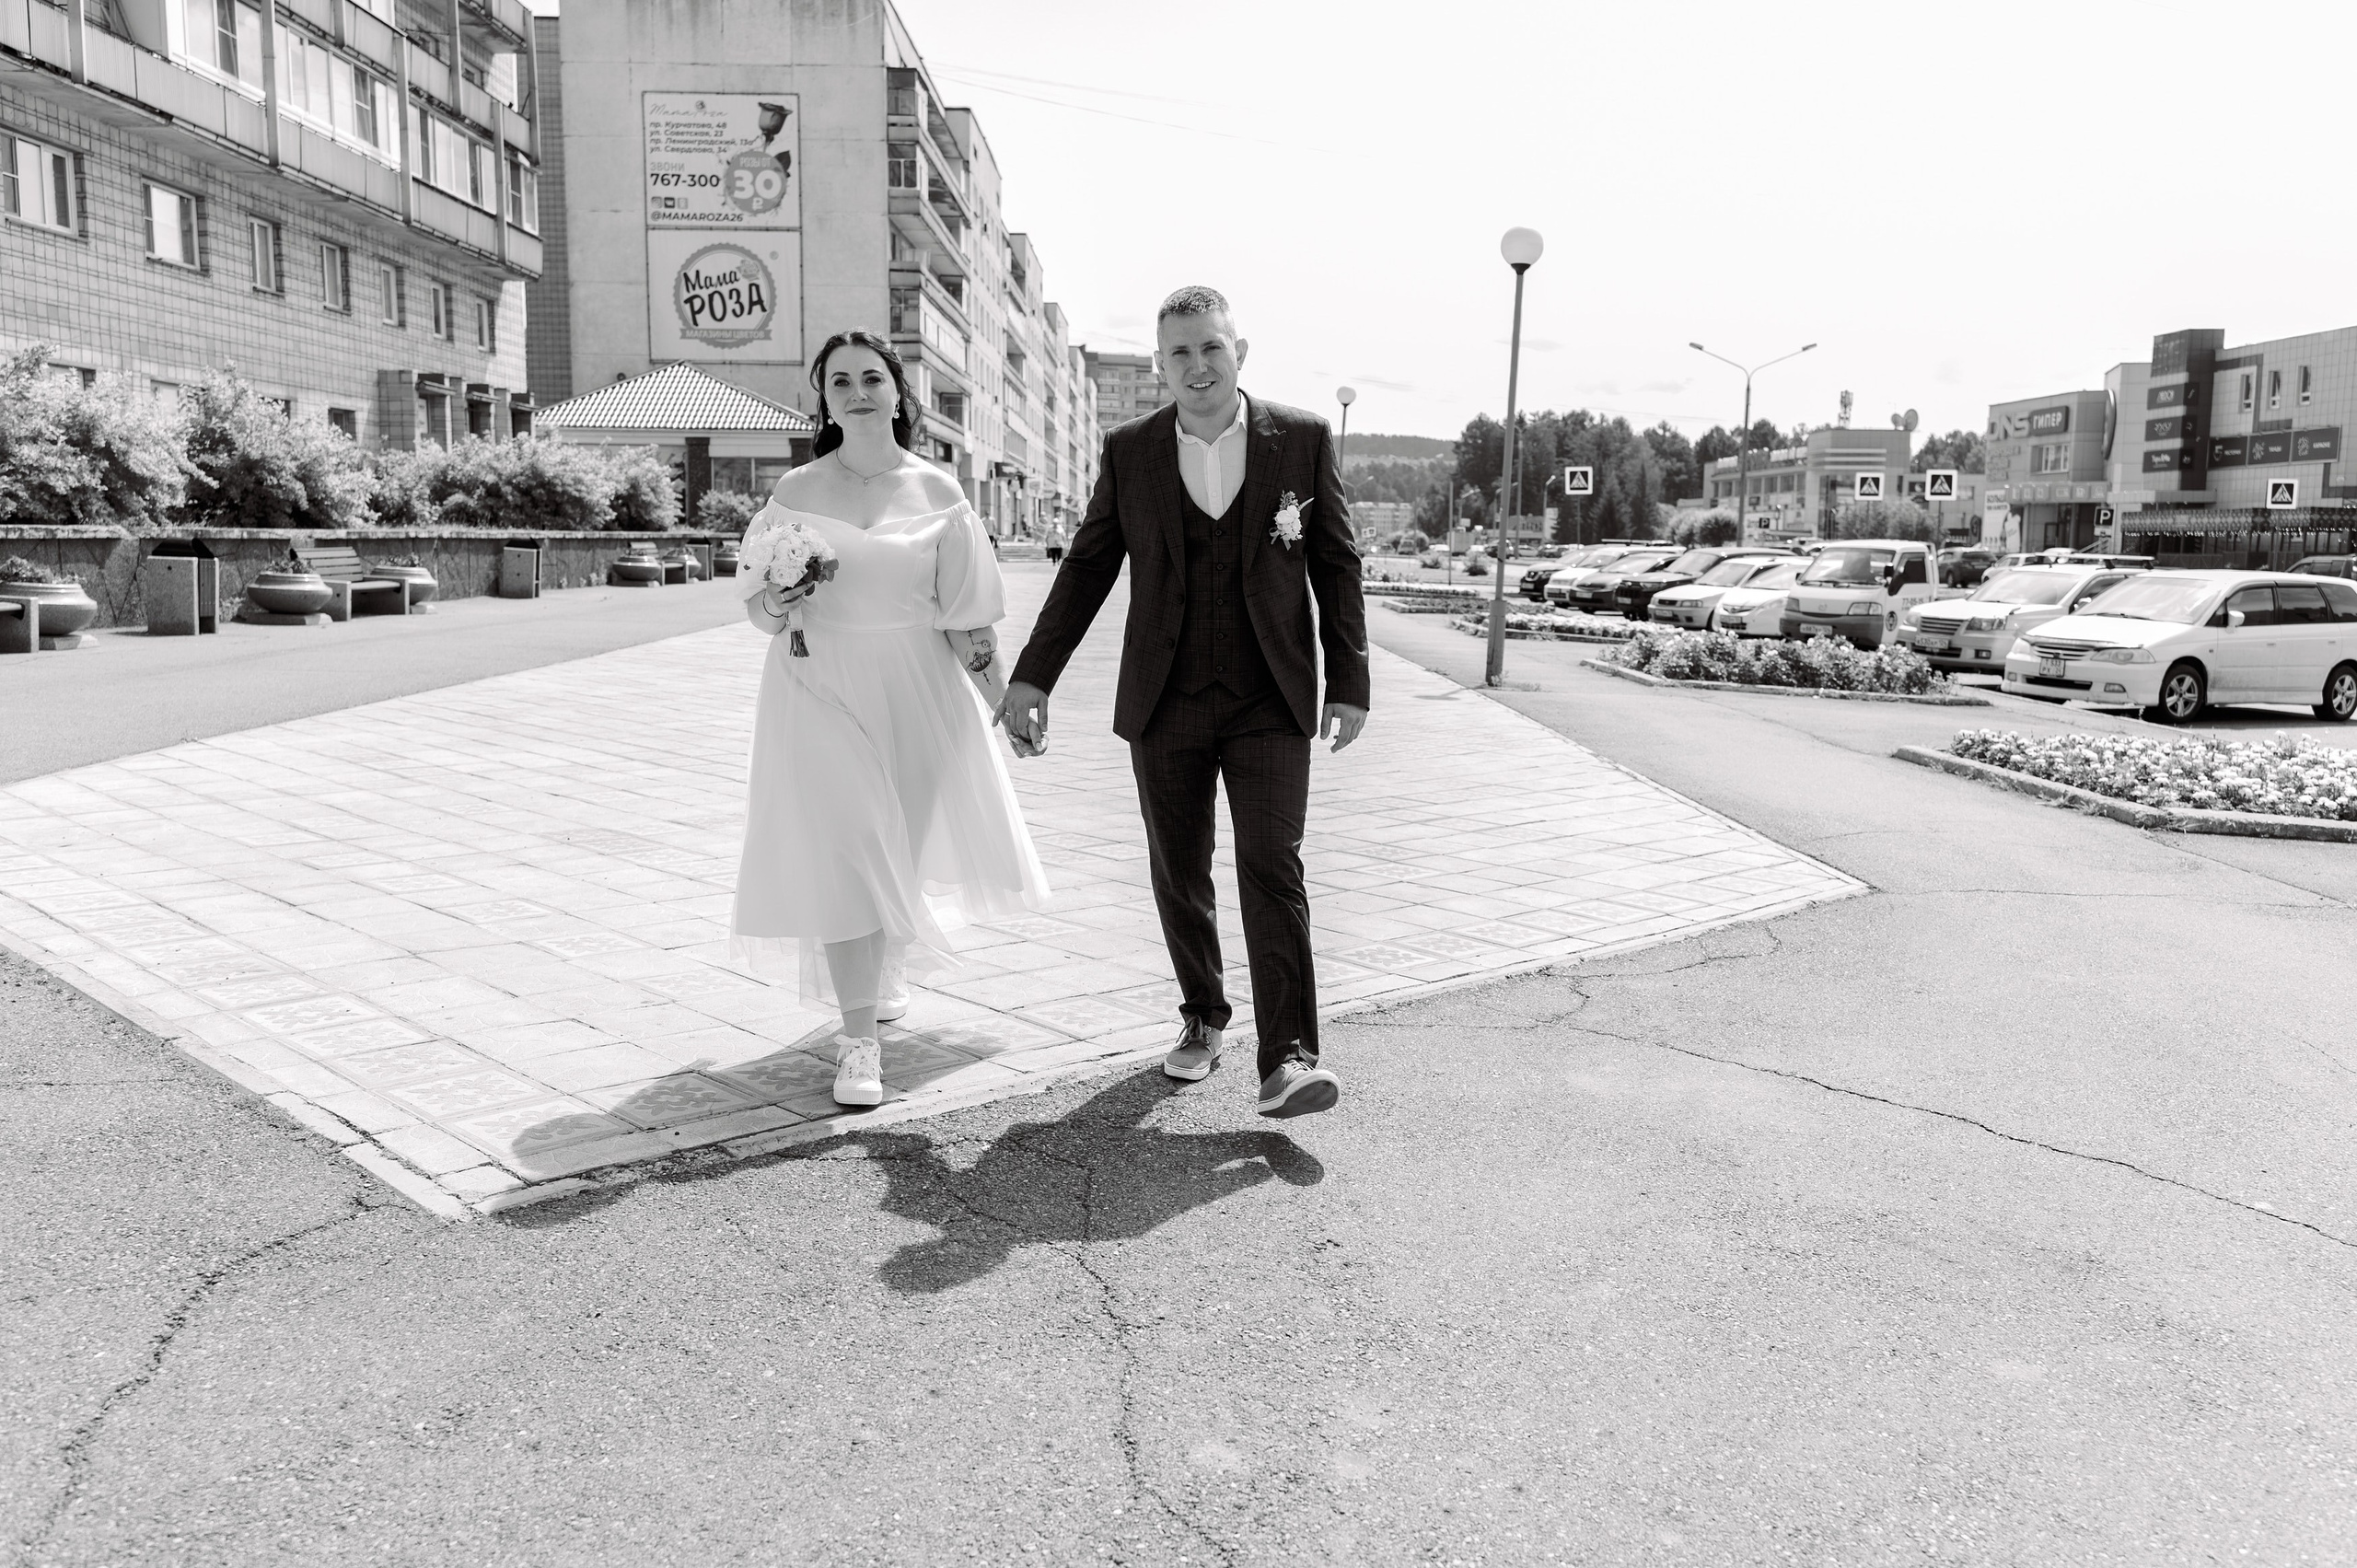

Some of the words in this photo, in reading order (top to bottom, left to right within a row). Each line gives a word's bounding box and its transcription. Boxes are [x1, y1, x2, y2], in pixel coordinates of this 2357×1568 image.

[665, 121, 714, 129] Курчатова,
[664, 129, 712, 137] Советская,
[650, 161, 685, 172] ЗВОНИ
[650, 173, 720, 187] 767-300
[734, 169, 782, 200] 30
[651, 211, 744, 222] @MAMAROZA26
[683, 269, 739, 294] Мама
[683, 283, 768, 327] РОЗА
[1989, 411, 2029, 442] DNS
[2032, 411, 2062, 430] ГИПЕР
[2100, 510, 2111, 525] P
